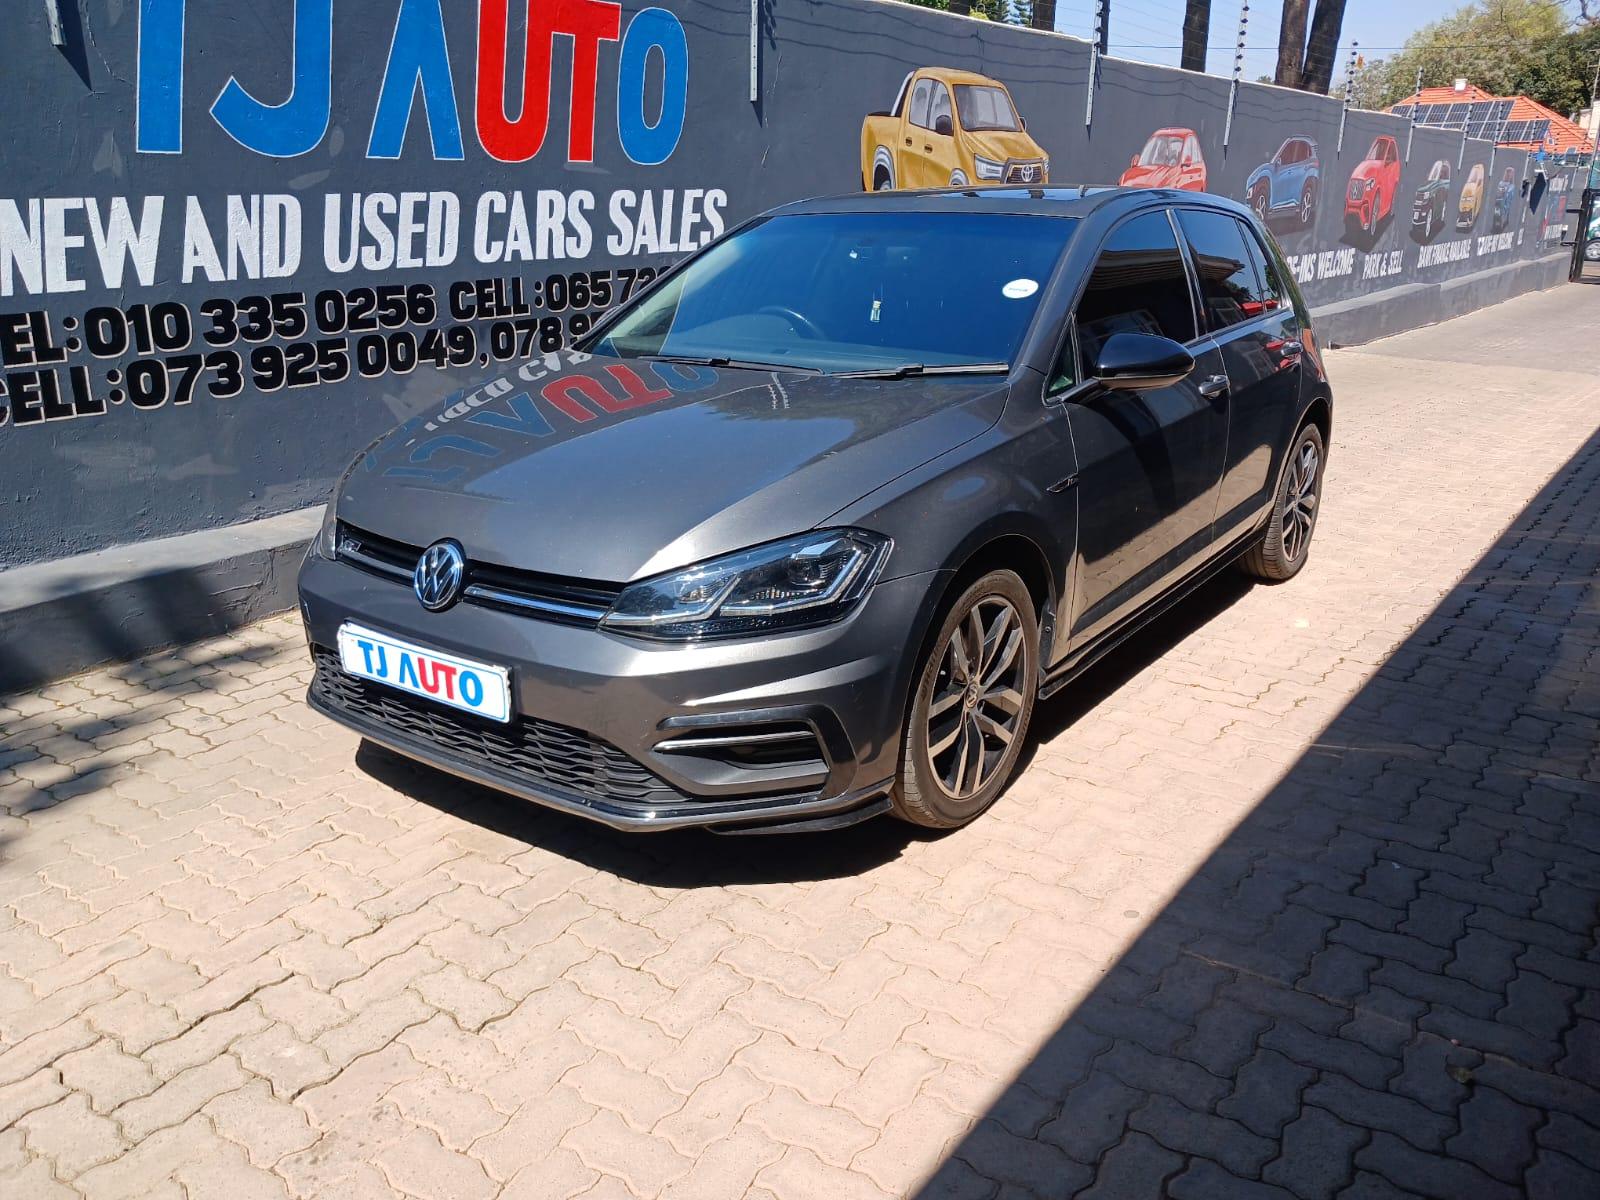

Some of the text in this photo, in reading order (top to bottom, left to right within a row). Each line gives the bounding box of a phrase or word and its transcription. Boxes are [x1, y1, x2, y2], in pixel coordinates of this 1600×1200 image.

[366, 0, 689, 165] AUTO
[0, 188, 728, 297] NEW AND USED CARS SALES
[1317, 247, 1356, 281] WELCOME
[1362, 254, 1382, 280] PARK
[1387, 249, 1404, 275] SELL
[200, 292, 308, 347] 335
[315, 283, 437, 334] 0256
[617, 264, 673, 304] 72
[251, 337, 350, 393] 925
[357, 639, 484, 707] TJ AUTO
